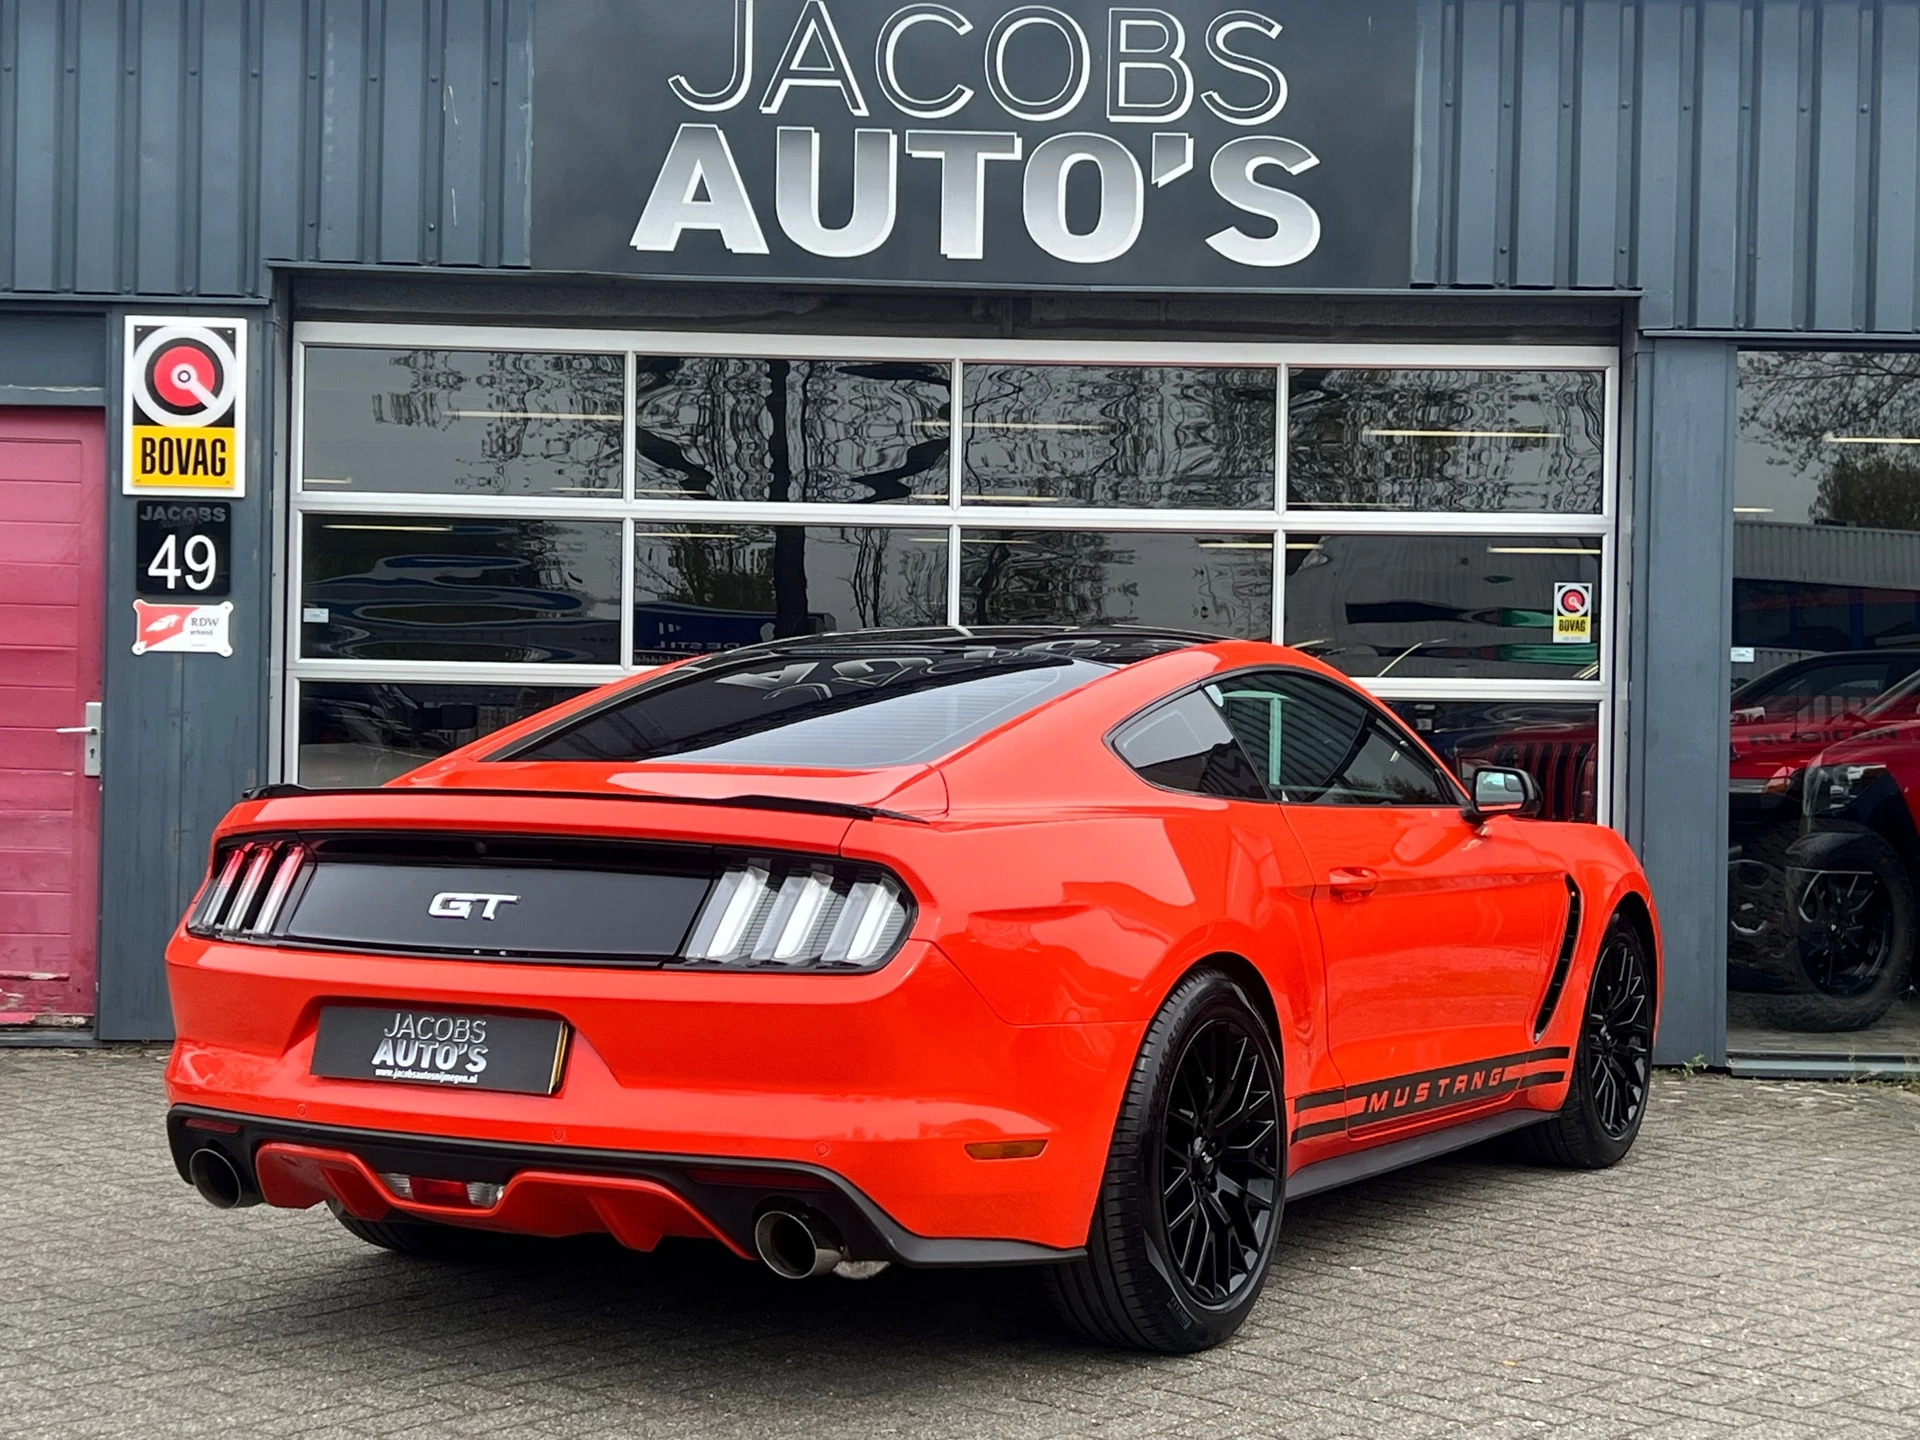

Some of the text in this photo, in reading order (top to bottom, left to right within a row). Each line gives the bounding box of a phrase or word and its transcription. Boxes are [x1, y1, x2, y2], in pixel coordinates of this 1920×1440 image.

[667, 0, 1289, 126] JACOBS
[629, 123, 1322, 267] AUTO'S
[141, 437, 226, 476] BOVAG
[140, 506, 226, 523] JACOBS
[148, 534, 216, 591] 49
[190, 617, 220, 628] RDW
[1558, 619, 1586, 632] BOVAG
[428, 892, 521, 920] GT
[383, 1013, 487, 1043] JACOBS
[371, 1038, 489, 1073] AUTO'S
[1367, 1067, 1503, 1113] MUSTANG
